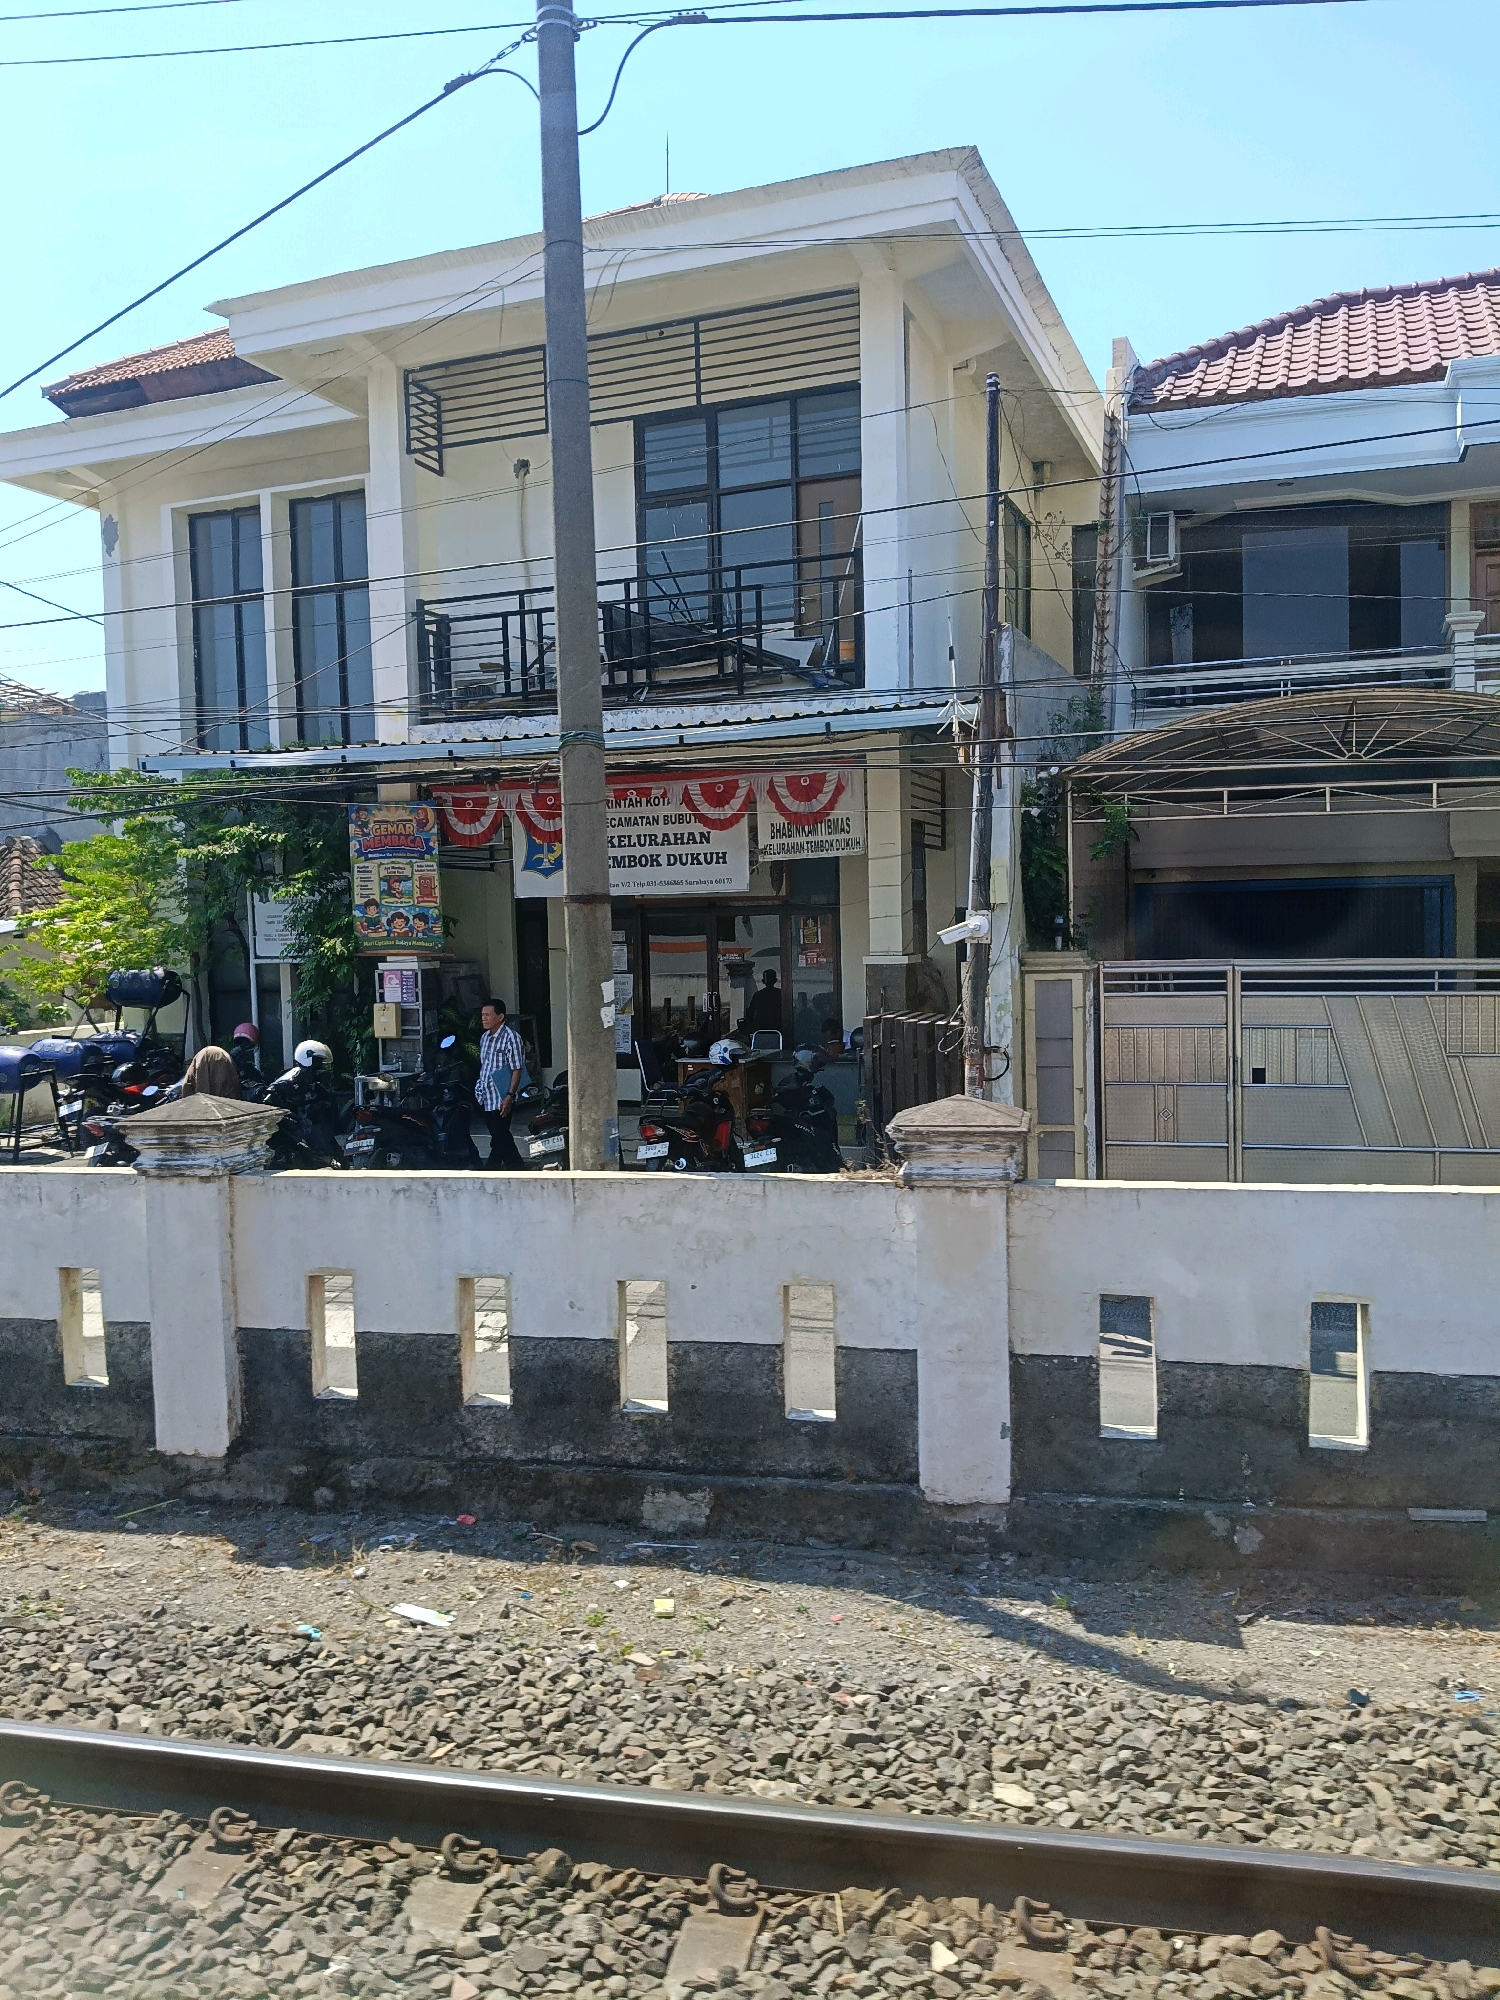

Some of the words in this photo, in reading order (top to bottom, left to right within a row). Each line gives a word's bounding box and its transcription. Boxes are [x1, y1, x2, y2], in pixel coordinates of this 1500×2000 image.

[606, 797, 642, 809] RINTAH
[372, 823, 414, 836] GEMAR
[363, 836, 424, 851] MEMBACA
[607, 831, 711, 848] KELURAHAN
[763, 841, 805, 856] KELURAHAN
[806, 839, 835, 854] TEMBOK
[836, 837, 862, 851] DUKUH
[666, 851, 728, 866] DUKUH
